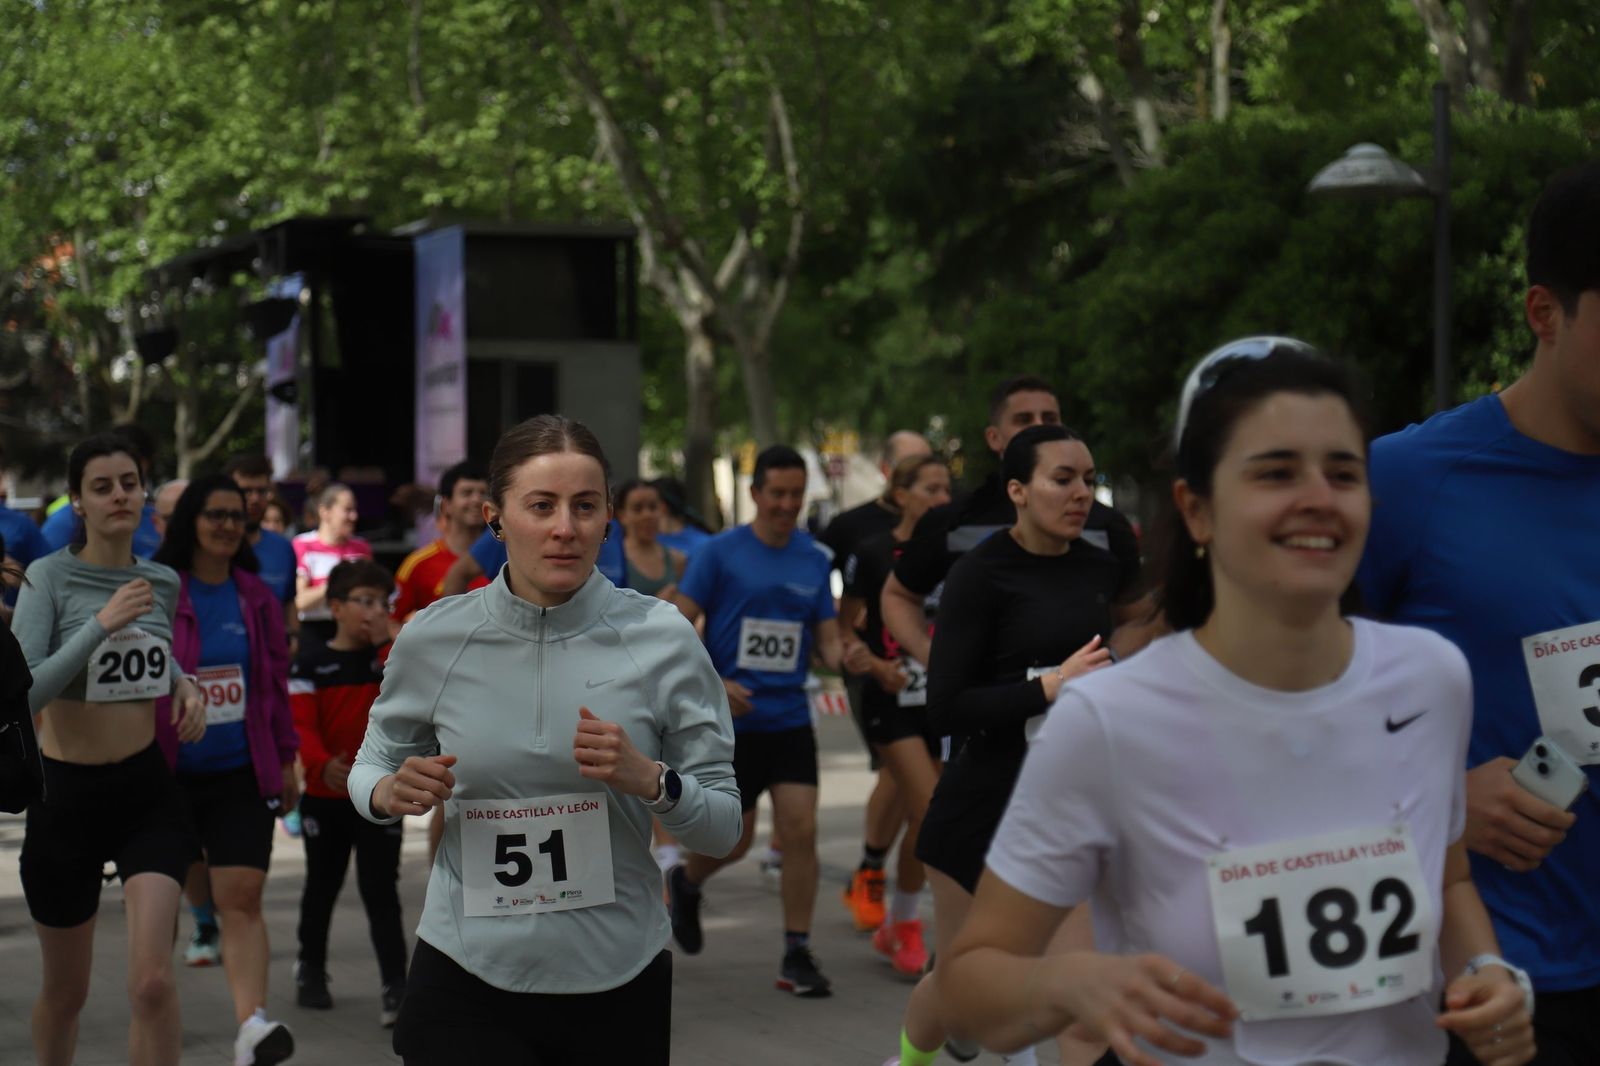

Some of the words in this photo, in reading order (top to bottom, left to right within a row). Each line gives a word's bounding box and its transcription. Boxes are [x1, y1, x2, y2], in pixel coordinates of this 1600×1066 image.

[98, 646, 165, 684] 209
[747, 634, 796, 659] 203
[1534, 644, 1559, 659] DÍA
[1561, 639, 1577, 652] DE
[467, 808, 484, 820] DÍA
[487, 810, 500, 820] DE
[503, 806, 555, 819] CASTILLA
[557, 805, 565, 815] Y
[568, 800, 599, 814] LEÓN
[494, 829, 567, 887] 51
[1220, 865, 1252, 883] DÍA
[1255, 860, 1279, 878] DE
[1284, 847, 1357, 872] CASTILLA
[1357, 845, 1368, 857] Y
[1369, 838, 1406, 858] LEÓN
[1244, 877, 1420, 978] 182
